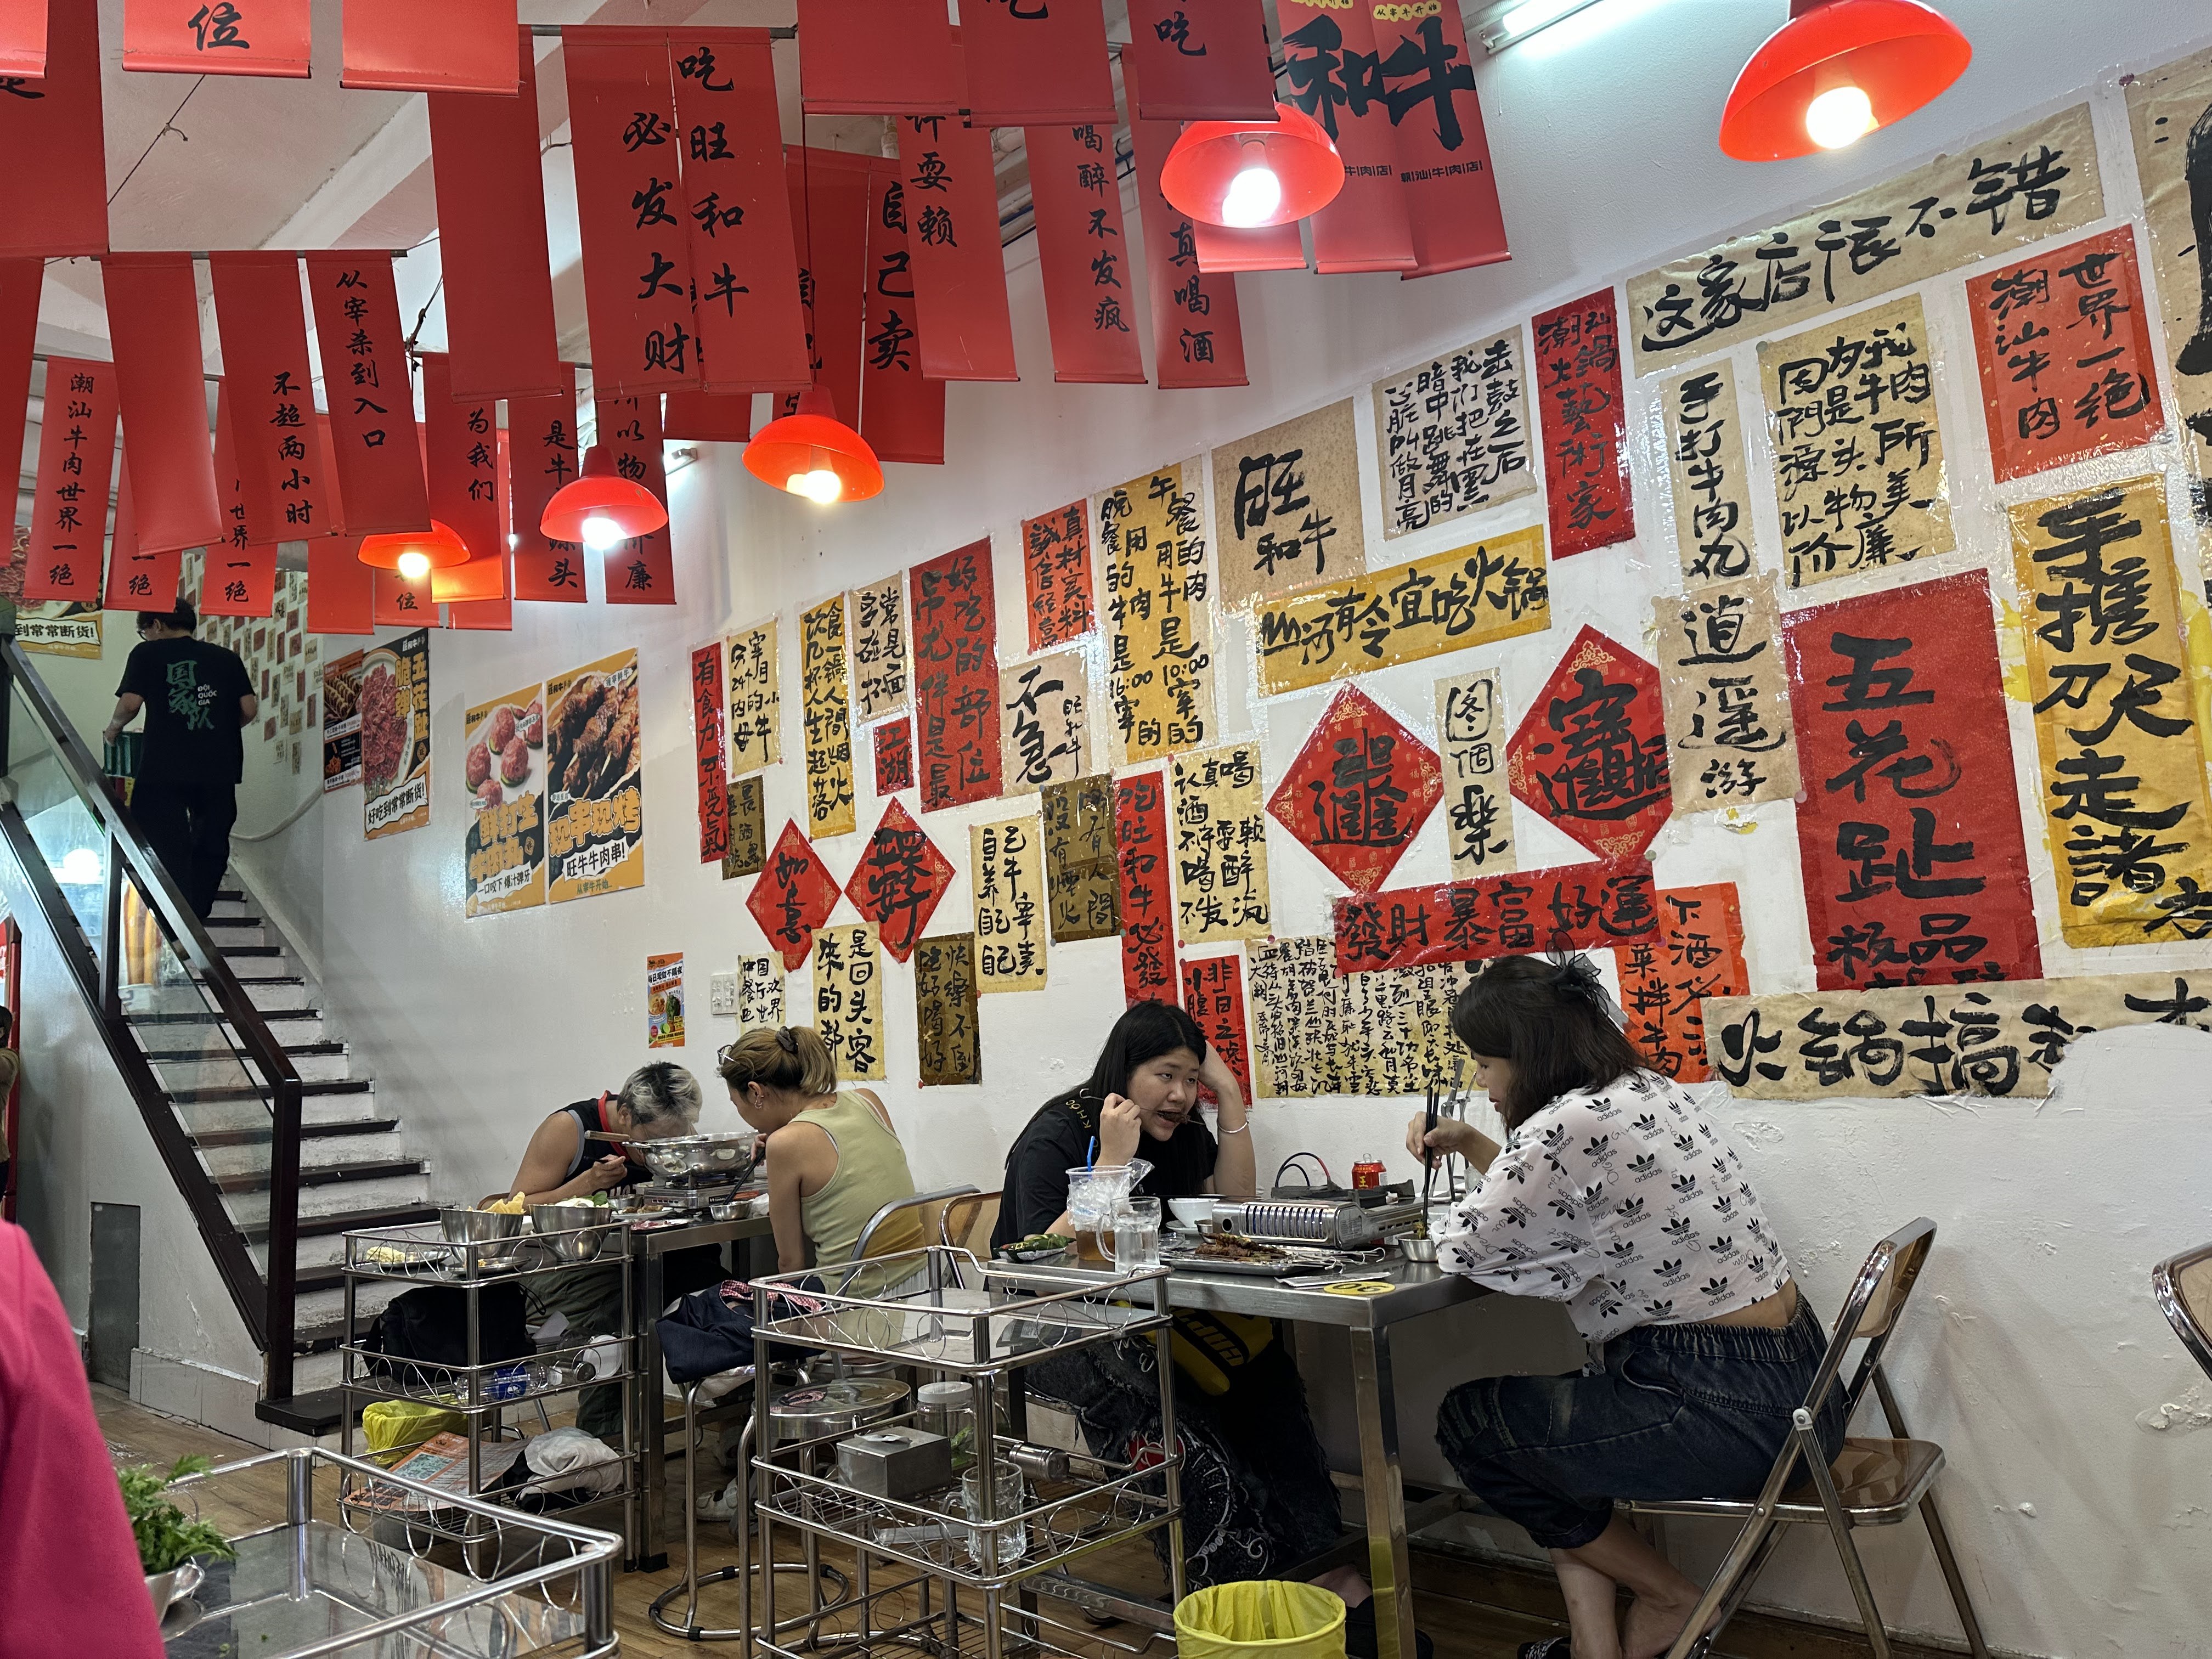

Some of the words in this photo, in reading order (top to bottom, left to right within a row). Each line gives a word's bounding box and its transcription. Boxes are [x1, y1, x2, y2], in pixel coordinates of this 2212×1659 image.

[188, 3, 250, 50] 位
[1154, 11, 1206, 55] 吃
[676, 47, 749, 318] 吃旺和牛
[1073, 126, 1130, 332] 喝醉不发疯
[623, 112, 690, 374] 必发大财
[336, 270, 388, 448] 从宰杀到入口
[269, 373, 313, 524] 不超两小时
[466, 410, 494, 503] 为我们
[49, 374, 94, 587] 潮汕牛肉世界一绝
[1675, 372, 1750, 580] 手打牛肉丸
[368, 782, 425, 825] 好吃到常常断货!
[1641, 1092, 1658, 1102] adidas
[1598, 1108, 1622, 1121] adidas
[1643, 1127, 1664, 1141] adidas
[1592, 1148, 1617, 1168] adidas
[1683, 1148, 1702, 1161] adidas
[1634, 1167, 1662, 1183] adidas
[1558, 1188, 1584, 1209] adidas
[1587, 1195, 1609, 1211] didas
[1679, 1189, 1703, 1204] adidas
[1512, 1197, 1537, 1218] adidas
[1722, 1210, 1739, 1223] adidas
[1623, 1211, 1651, 1228] adidas
[1671, 1231, 1700, 1246] adidas
[1462, 1240, 1486, 1261] adidas
[1717, 1249, 1740, 1264] adidas
[1615, 1254, 1644, 1268] adidas
[1662, 1272, 1691, 1288] adidas
[1589, 1290, 1610, 1307] adidas
[1708, 1290, 1735, 1306] adidas
